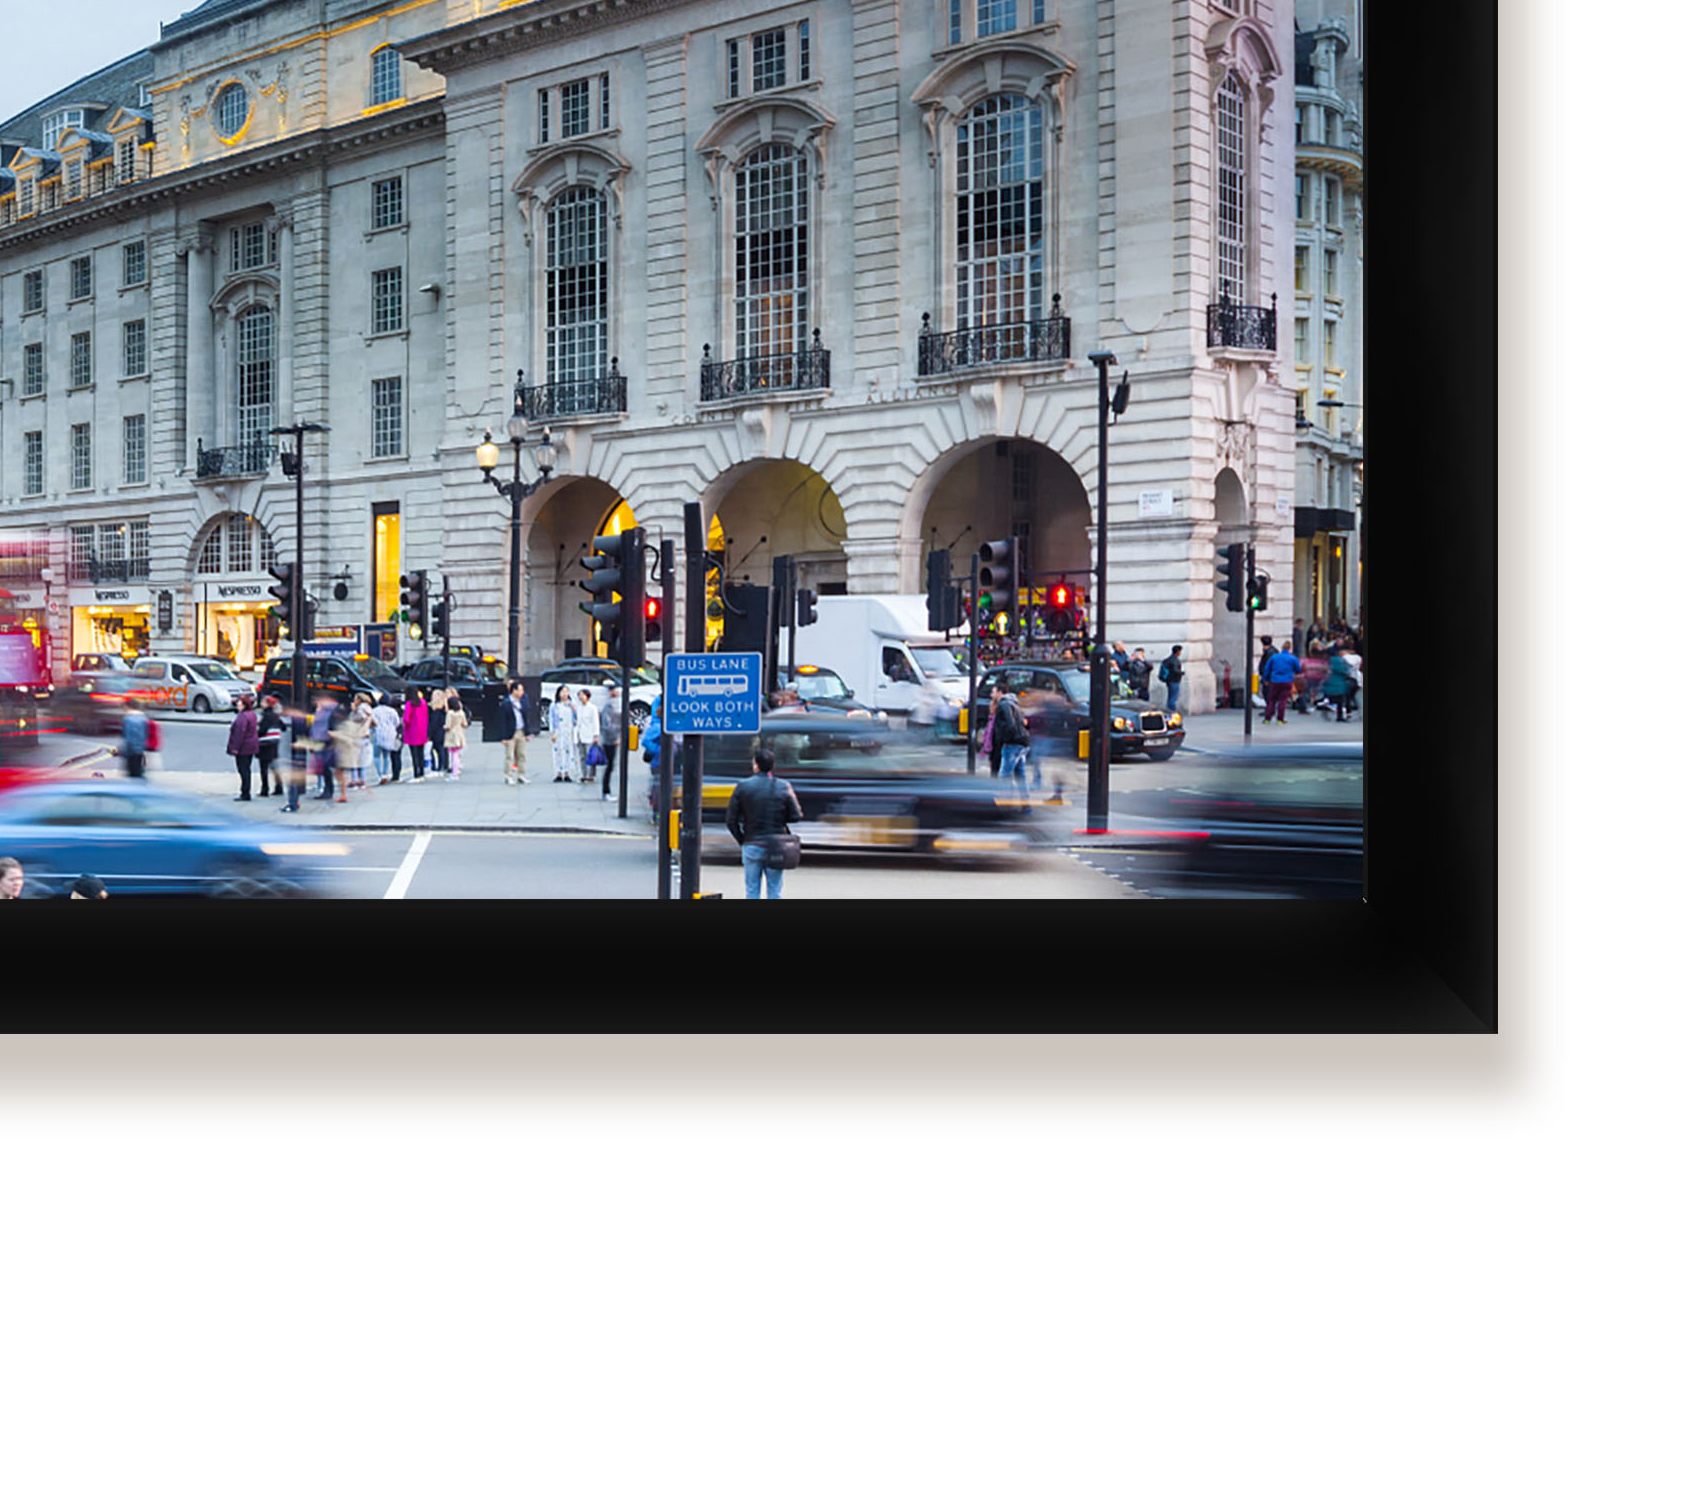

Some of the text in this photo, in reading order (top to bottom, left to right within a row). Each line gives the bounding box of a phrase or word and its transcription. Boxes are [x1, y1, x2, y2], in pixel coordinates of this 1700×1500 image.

[95, 589, 129, 601] NESPRESSO
[218, 585, 261, 598] NESPRESSO
[677, 658, 749, 671] BUS LANE
[671, 701, 754, 713] LOOK BOTH
[693, 716, 732, 728] WAYS
